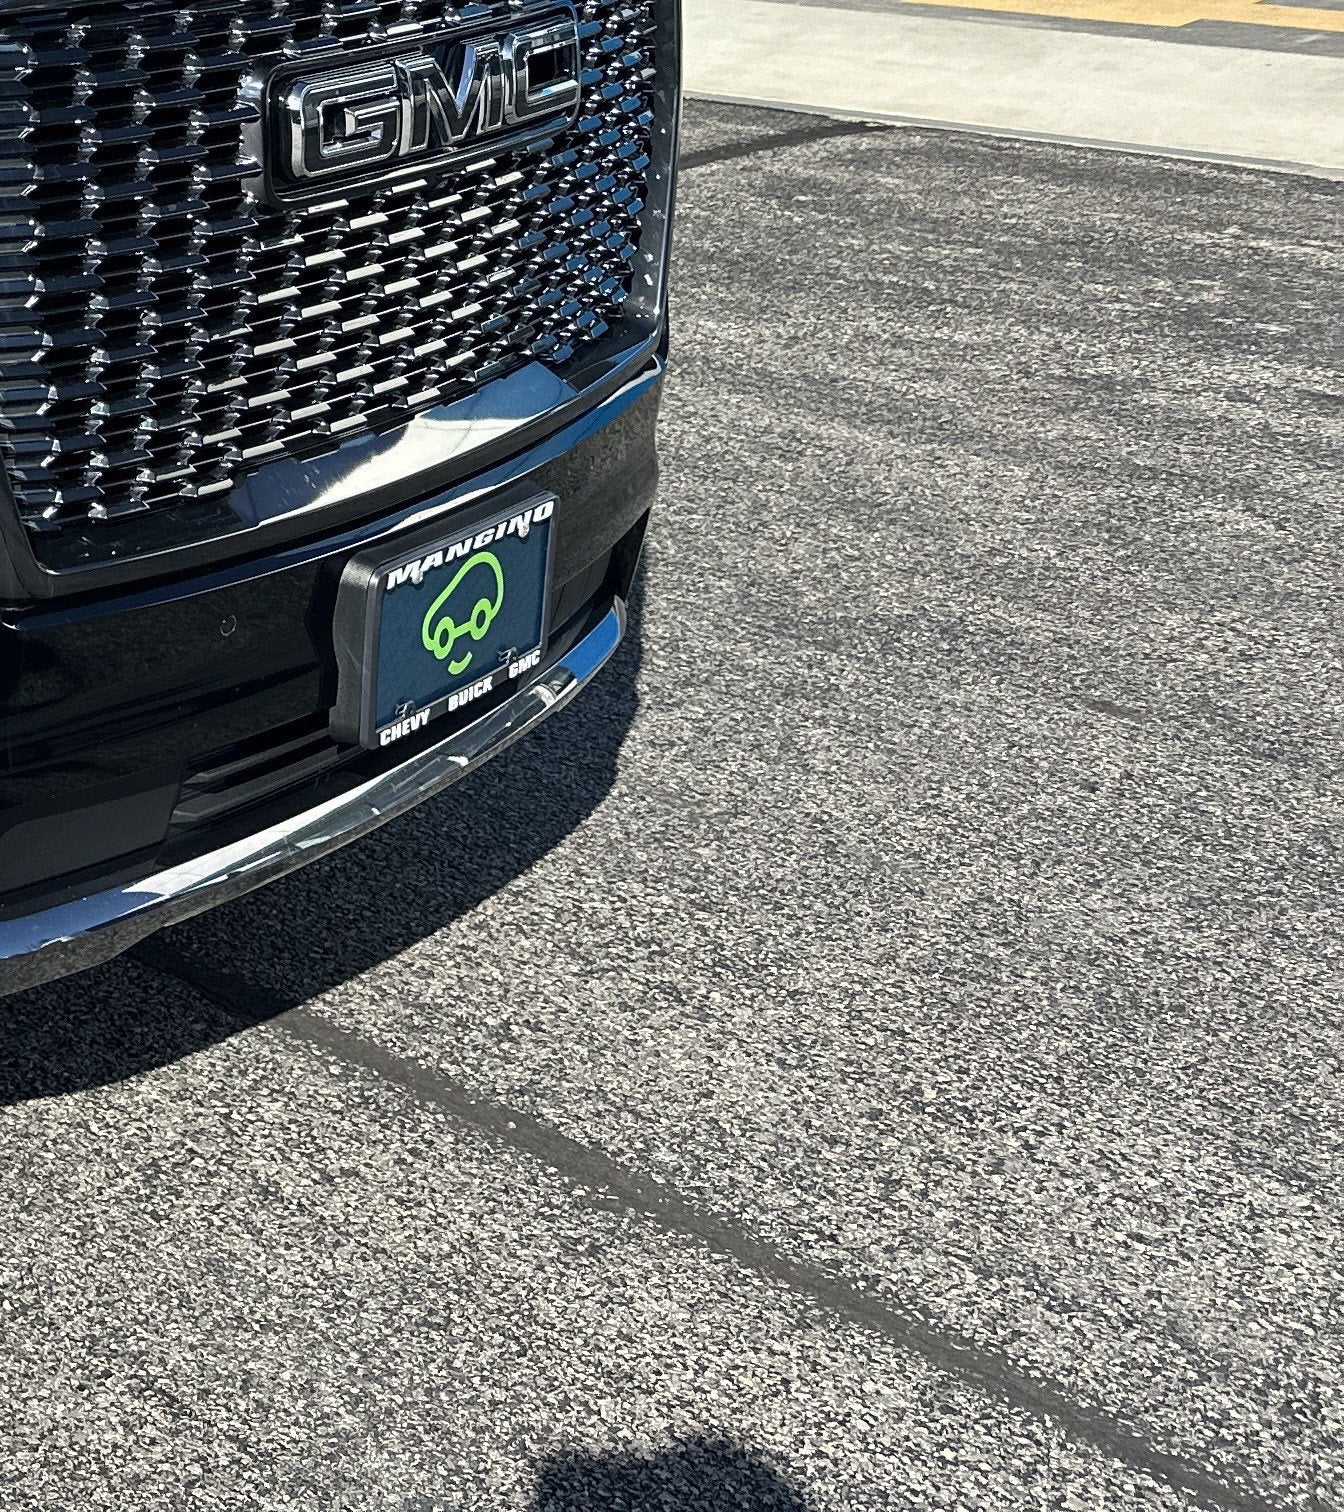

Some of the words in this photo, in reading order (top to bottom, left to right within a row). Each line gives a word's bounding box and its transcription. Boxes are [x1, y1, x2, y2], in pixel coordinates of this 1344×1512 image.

[292, 16, 580, 178] GMC
[386, 500, 555, 590] MANGINO
[379, 708, 431, 747] CHEVY
[448, 675, 494, 712] BUICK
[508, 649, 541, 679] GMC
